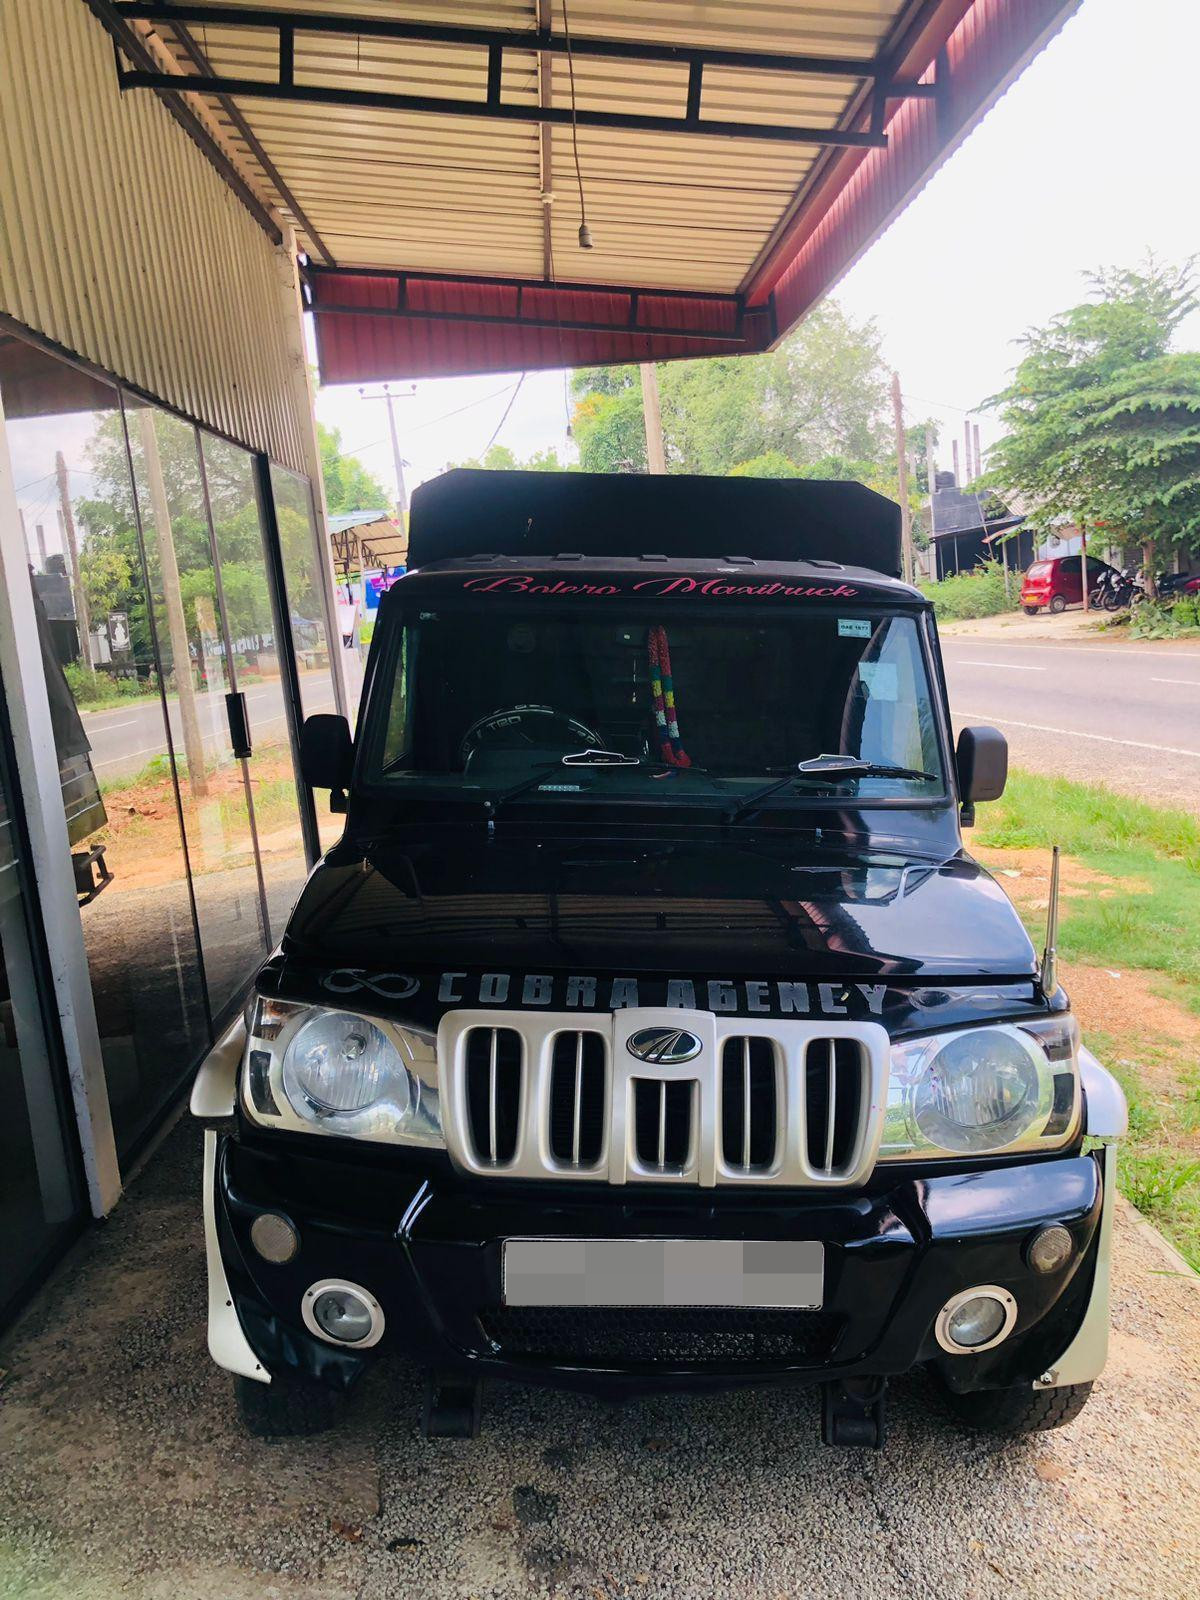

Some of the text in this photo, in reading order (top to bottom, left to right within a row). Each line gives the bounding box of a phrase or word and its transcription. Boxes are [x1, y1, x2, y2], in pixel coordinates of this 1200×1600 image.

[463, 576, 859, 597] Bolero Maxitruck
[438, 972, 888, 1015] COBRA AGENCY
